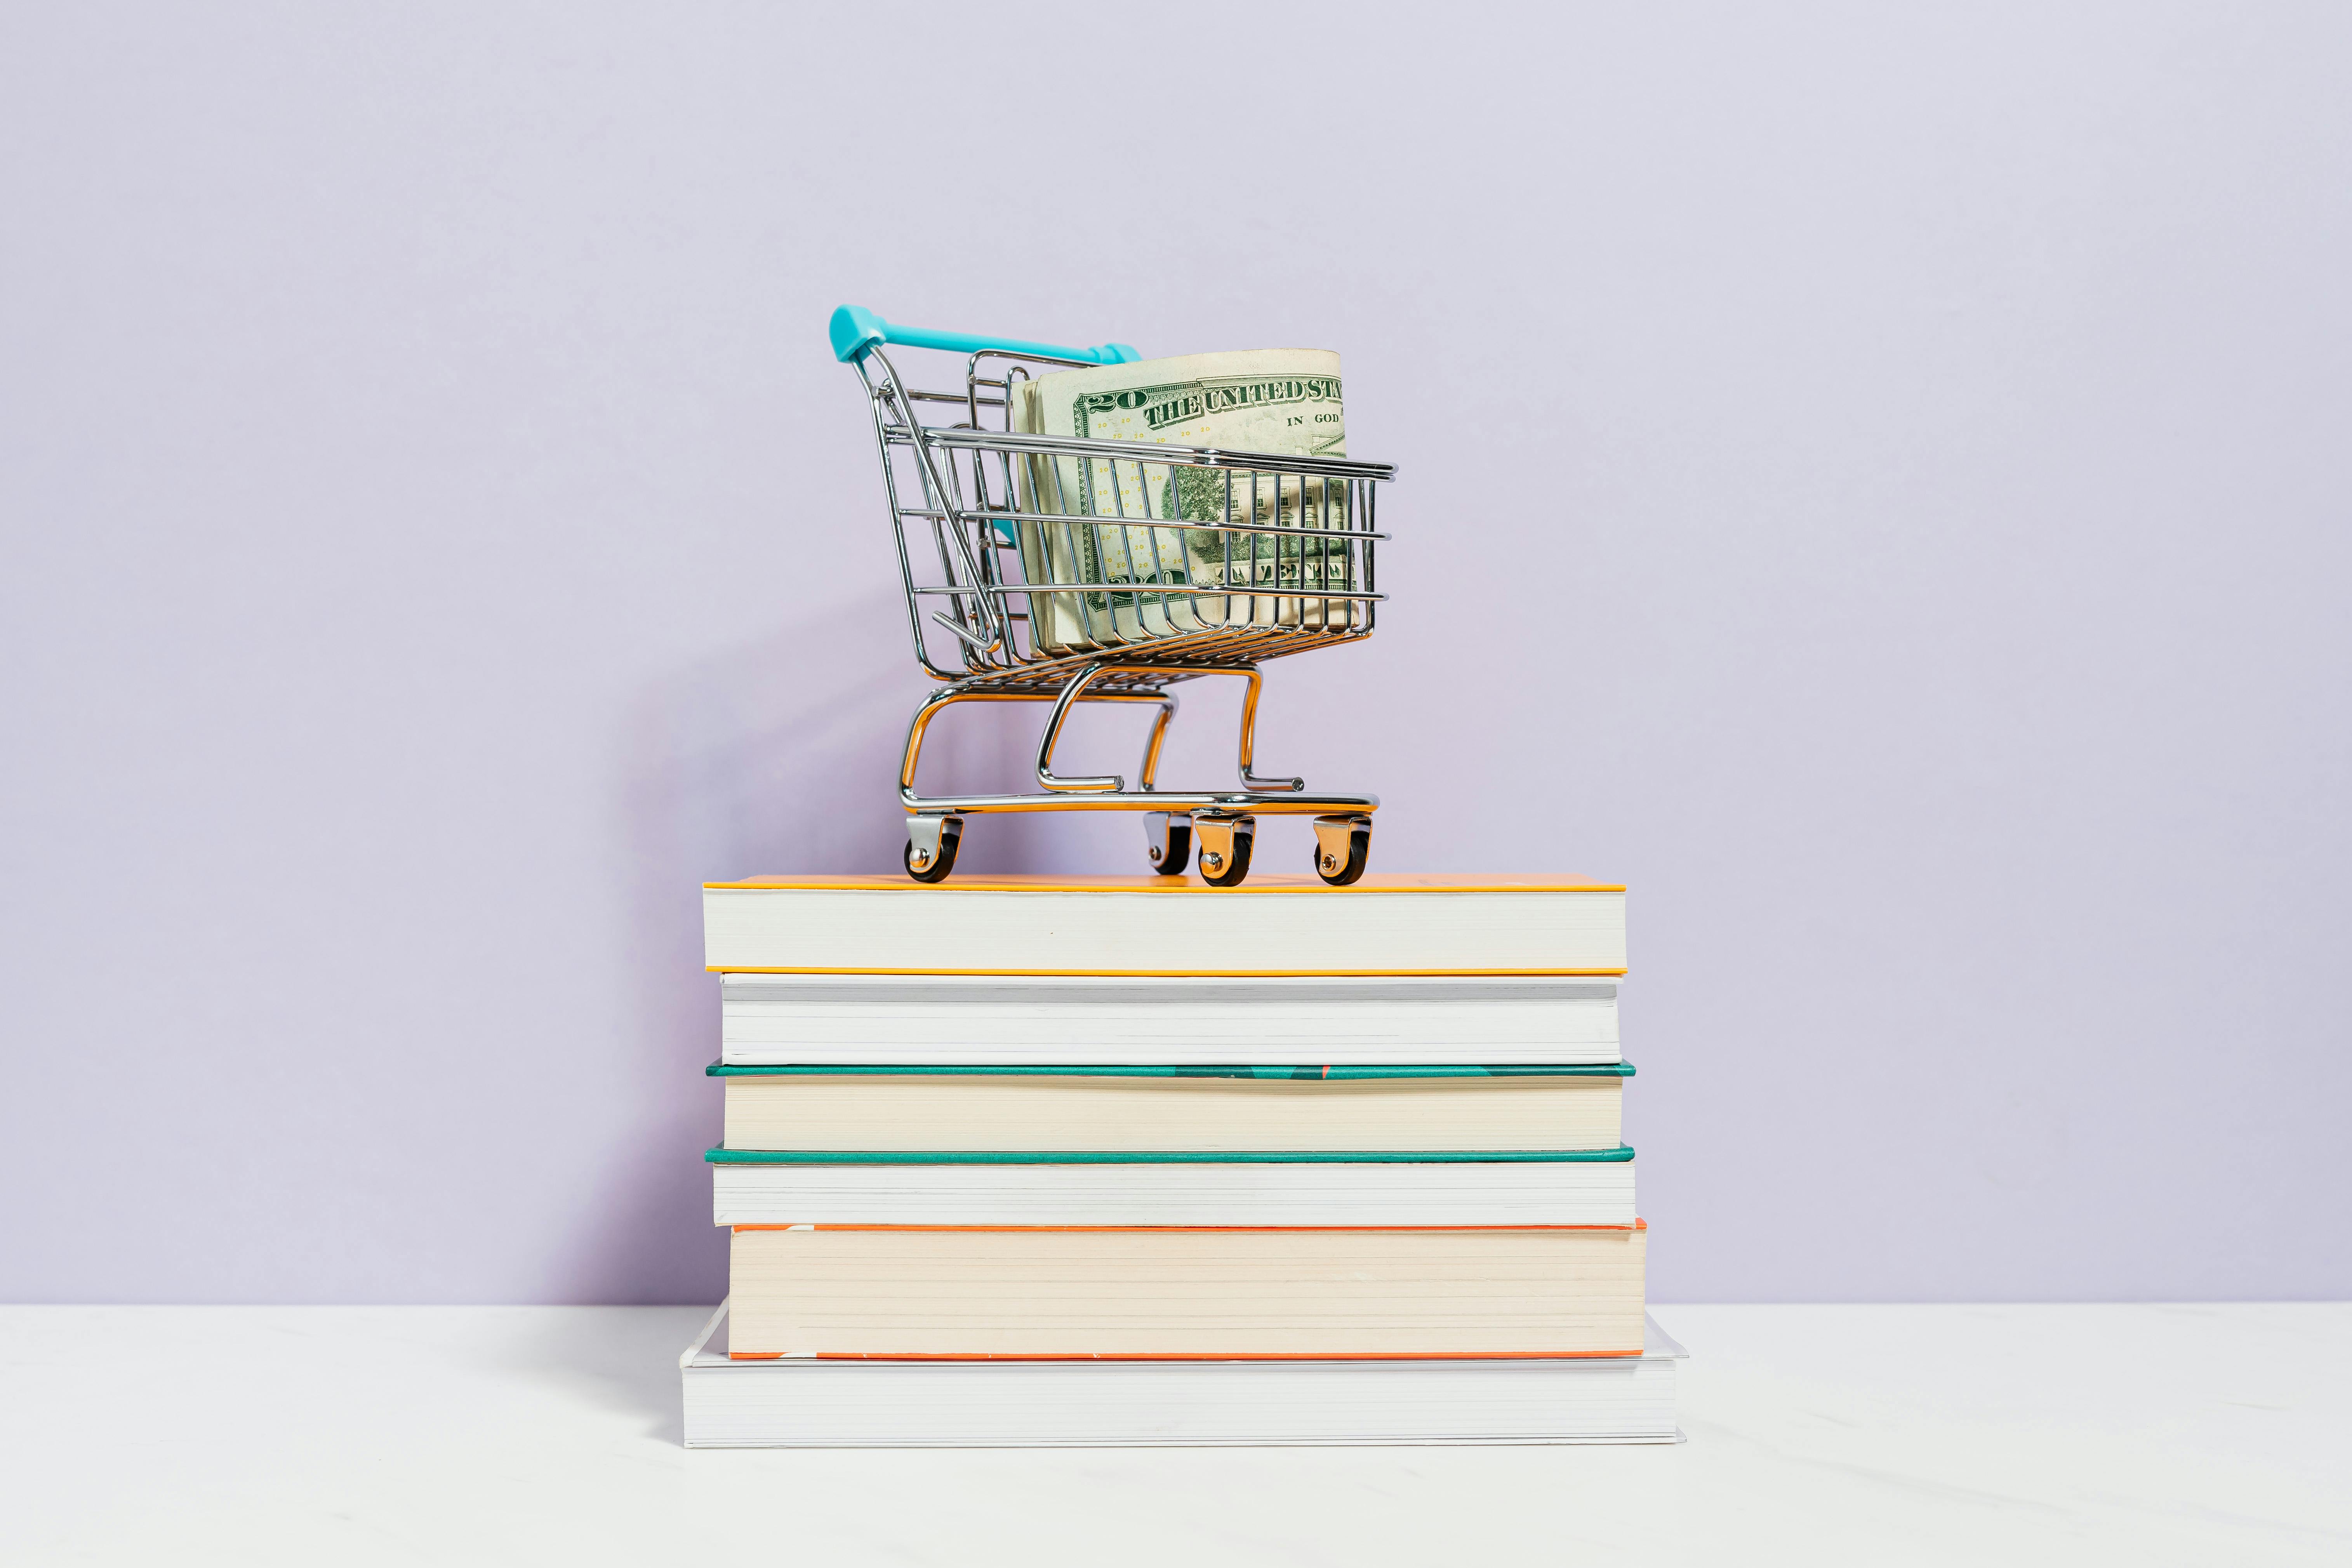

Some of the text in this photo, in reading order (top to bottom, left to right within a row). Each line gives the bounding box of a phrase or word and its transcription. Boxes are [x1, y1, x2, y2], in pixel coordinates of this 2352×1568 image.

[1086, 390, 1149, 414] 20
[1143, 395, 1205, 431] THE
[1204, 381, 1307, 414] UNITED
[1286, 414, 1339, 426] IN GOD
